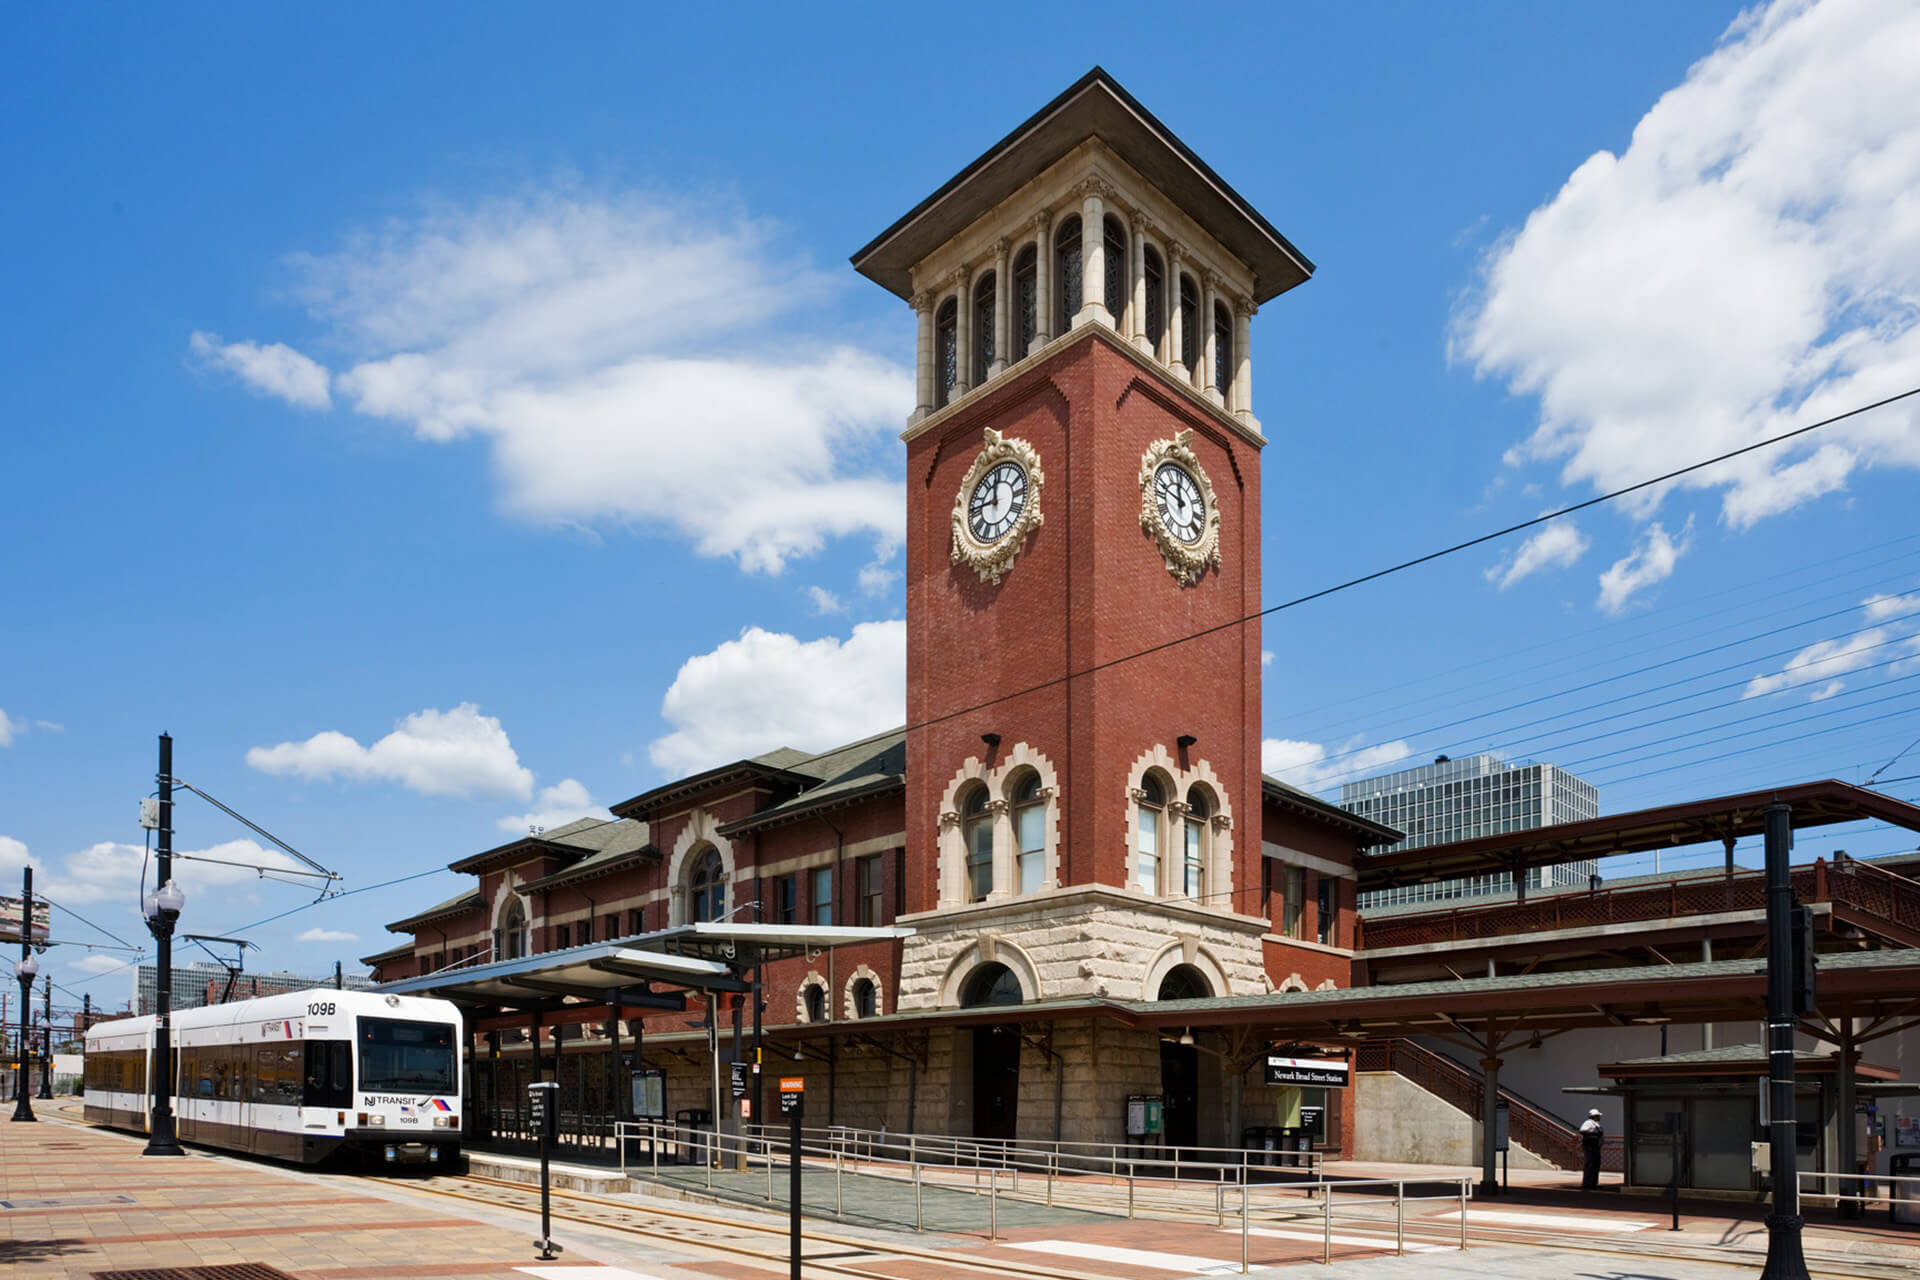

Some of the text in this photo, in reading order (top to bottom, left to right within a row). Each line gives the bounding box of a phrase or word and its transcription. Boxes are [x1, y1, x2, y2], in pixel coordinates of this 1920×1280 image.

[307, 1002, 336, 1016] 109B
[1274, 1070, 1295, 1080] Newark
[377, 1096, 416, 1105] TRANSIT
